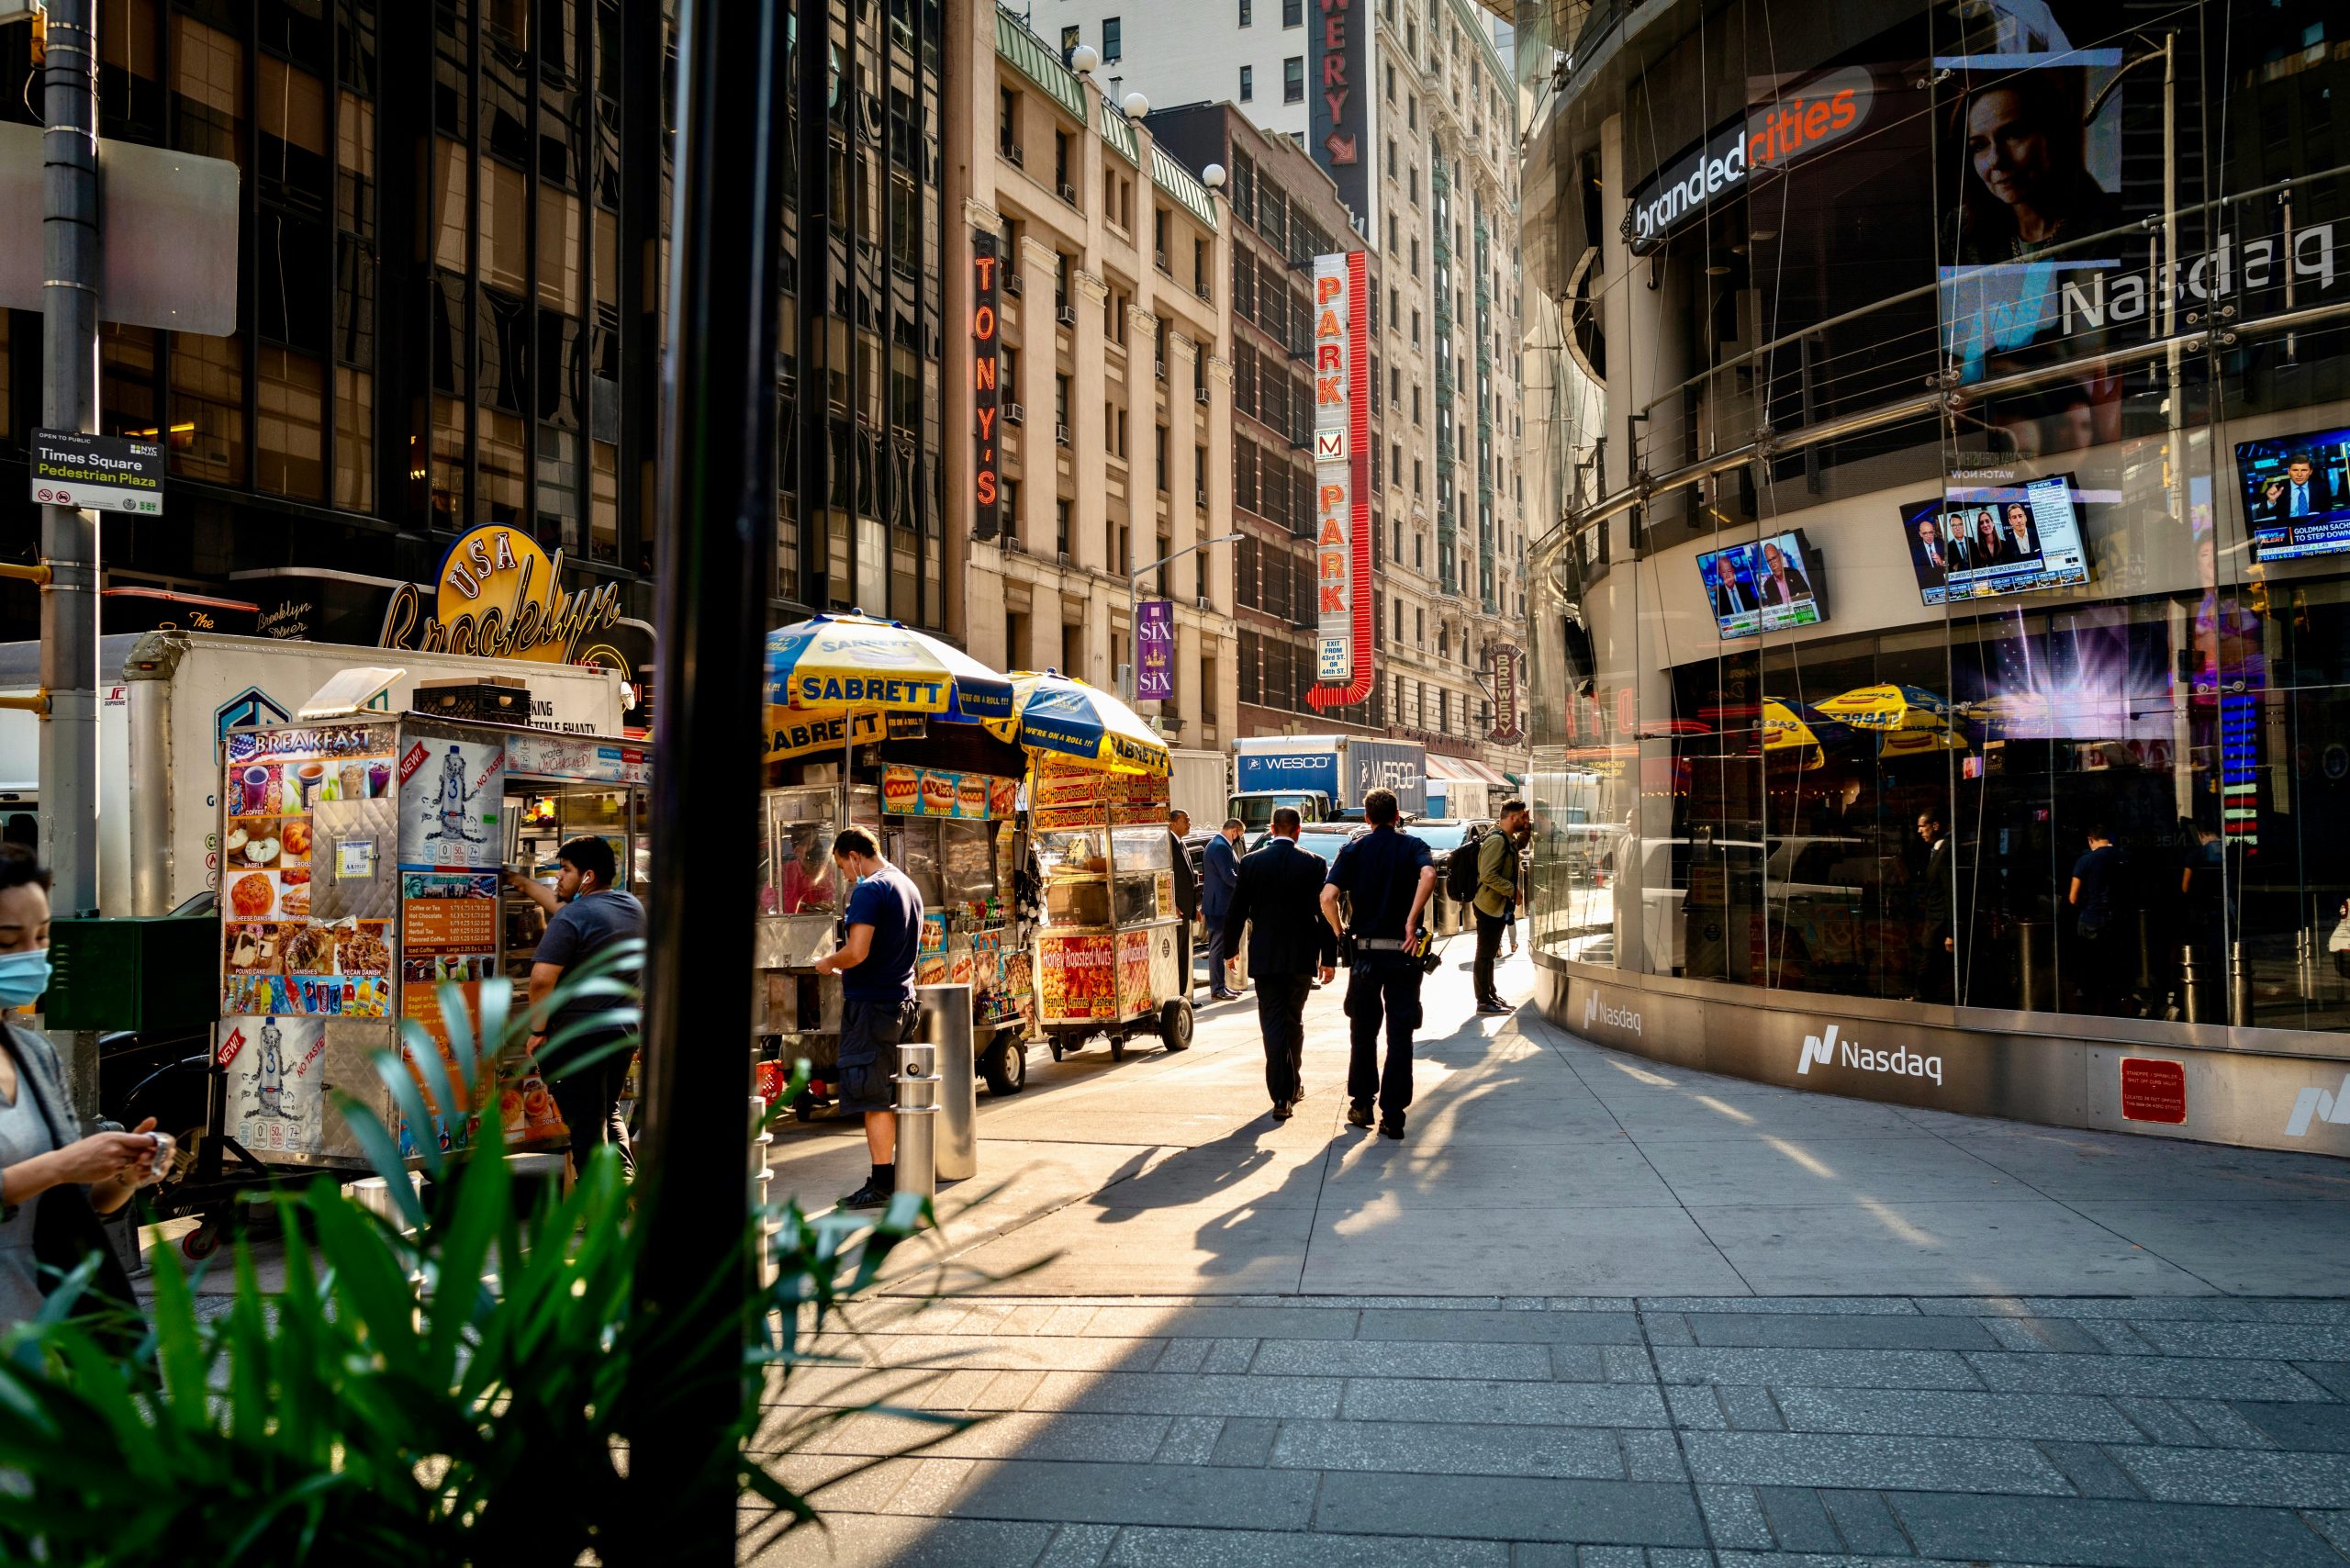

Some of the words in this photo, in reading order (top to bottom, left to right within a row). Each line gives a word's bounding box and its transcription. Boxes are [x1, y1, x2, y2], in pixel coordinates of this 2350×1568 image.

[2062, 224, 2334, 336] Nasdaq
[1316, 277, 1342, 404] PARK
[976, 258, 996, 503] TONY'S
[39, 447, 85, 464] Times
[89, 454, 143, 470] Square
[39, 464, 116, 483] Pedestrian
[119, 473, 157, 487] Plaza
[2294, 524, 2328, 535] GOLDMAN
[1319, 485, 1345, 614] PARK
[446, 532, 517, 599] USA
[1949, 571, 1966, 580] ONGRESS
[1989, 566, 2008, 574] MULTIPLE
[2023, 562, 2041, 570] BATTLES
[257, 600, 313, 632] Brooklyn
[377, 547, 621, 665] Brooklyn
[189, 611, 215, 629] The
[801, 676, 943, 704] SABRETT
[973, 694, 981, 703] ON
[986, 696, 1000, 705] ROLL
[1497, 654, 1512, 735] BREWERY
[255, 729, 373, 753] BREAKFAST
[538, 739, 550, 747] GET
[552, 740, 592, 752] CAFFEINATED
[1025, 726, 1047, 737] WE'RE
[1048, 732, 1059, 740] ON
[1066, 736, 1082, 746] ROLL
[400, 748, 422, 778] NEW!
[540, 748, 564, 759] water
[1266, 757, 1328, 769] WESCO
[477, 774, 487, 789] NO
[1371, 760, 1415, 789] WESCO
[448, 779, 458, 799] 3
[1050, 789, 1067, 802] Honey
[1068, 787, 1089, 798] Roasted
[1093, 785, 1106, 798] Nuts
[888, 804, 899, 813] HOT
[902, 804, 915, 814] DOG
[924, 807, 939, 815] CHILI
[940, 808, 951, 816] DOG
[1034, 813, 1046, 826] Nuts
[1050, 812, 1067, 824] Honey
[1068, 812, 1089, 823] Roasted
[1093, 810, 1106, 823] Nuts
[1043, 949, 1064, 971] Honey
[1066, 948, 1093, 967] Roasted
[1096, 947, 1111, 965] Nuts
[1044, 995, 1065, 1008] Peanuts
[1069, 997, 1088, 1008] Almonds
[1093, 995, 1115, 1007] Cashews
[1599, 1002, 1641, 1036] Nasdaq
[218, 1036, 240, 1064] NEW!
[266, 1053, 275, 1074] 3
[296, 1062, 307, 1078] NO
[1841, 1040, 1942, 1086] Nasdaq
[258, 1126, 263, 1137] 0
[271, 1127, 279, 1136] 50
[290, 1128, 299, 1137] 7+
